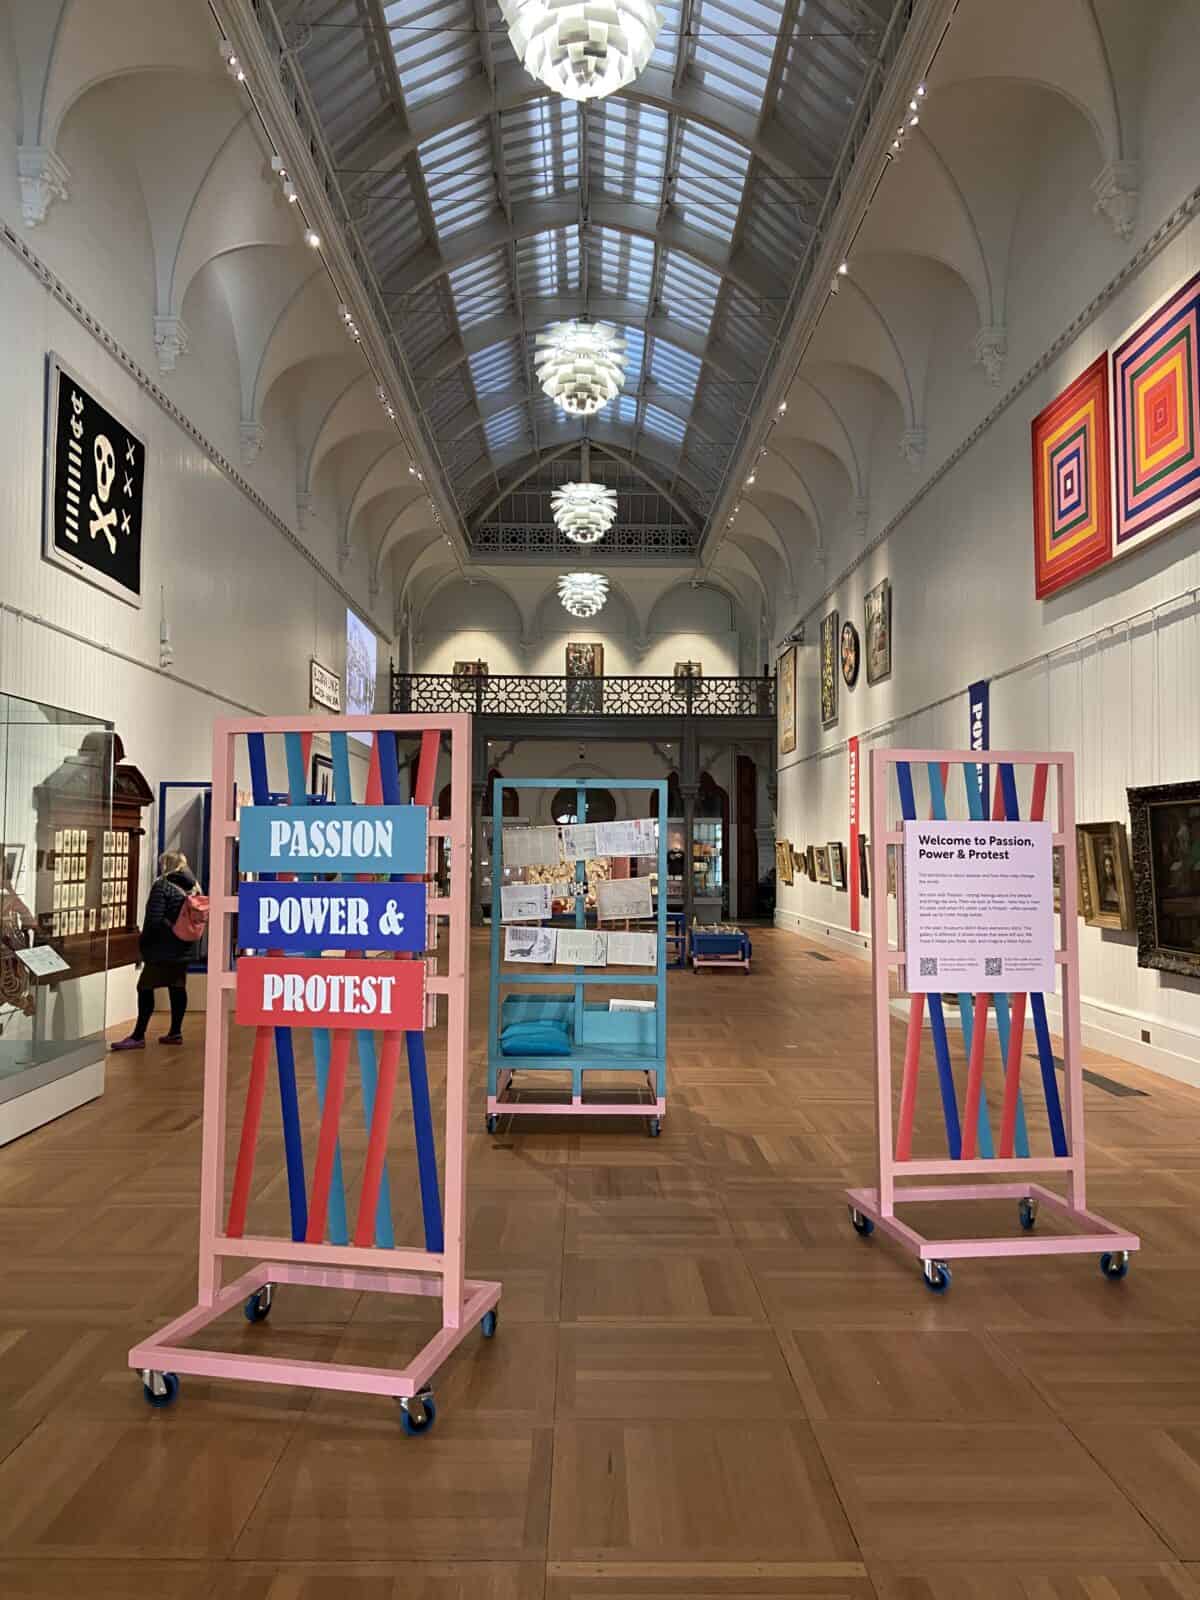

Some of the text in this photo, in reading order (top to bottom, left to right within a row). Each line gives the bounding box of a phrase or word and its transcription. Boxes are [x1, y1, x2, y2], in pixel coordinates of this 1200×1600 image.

[269, 819, 394, 858] PASSION
[918, 835, 1035, 848] Welcome to Passion,
[918, 849, 1010, 860] Power & Protest
[258, 897, 405, 936] POWER &
[262, 974, 396, 1015] PROTEST
